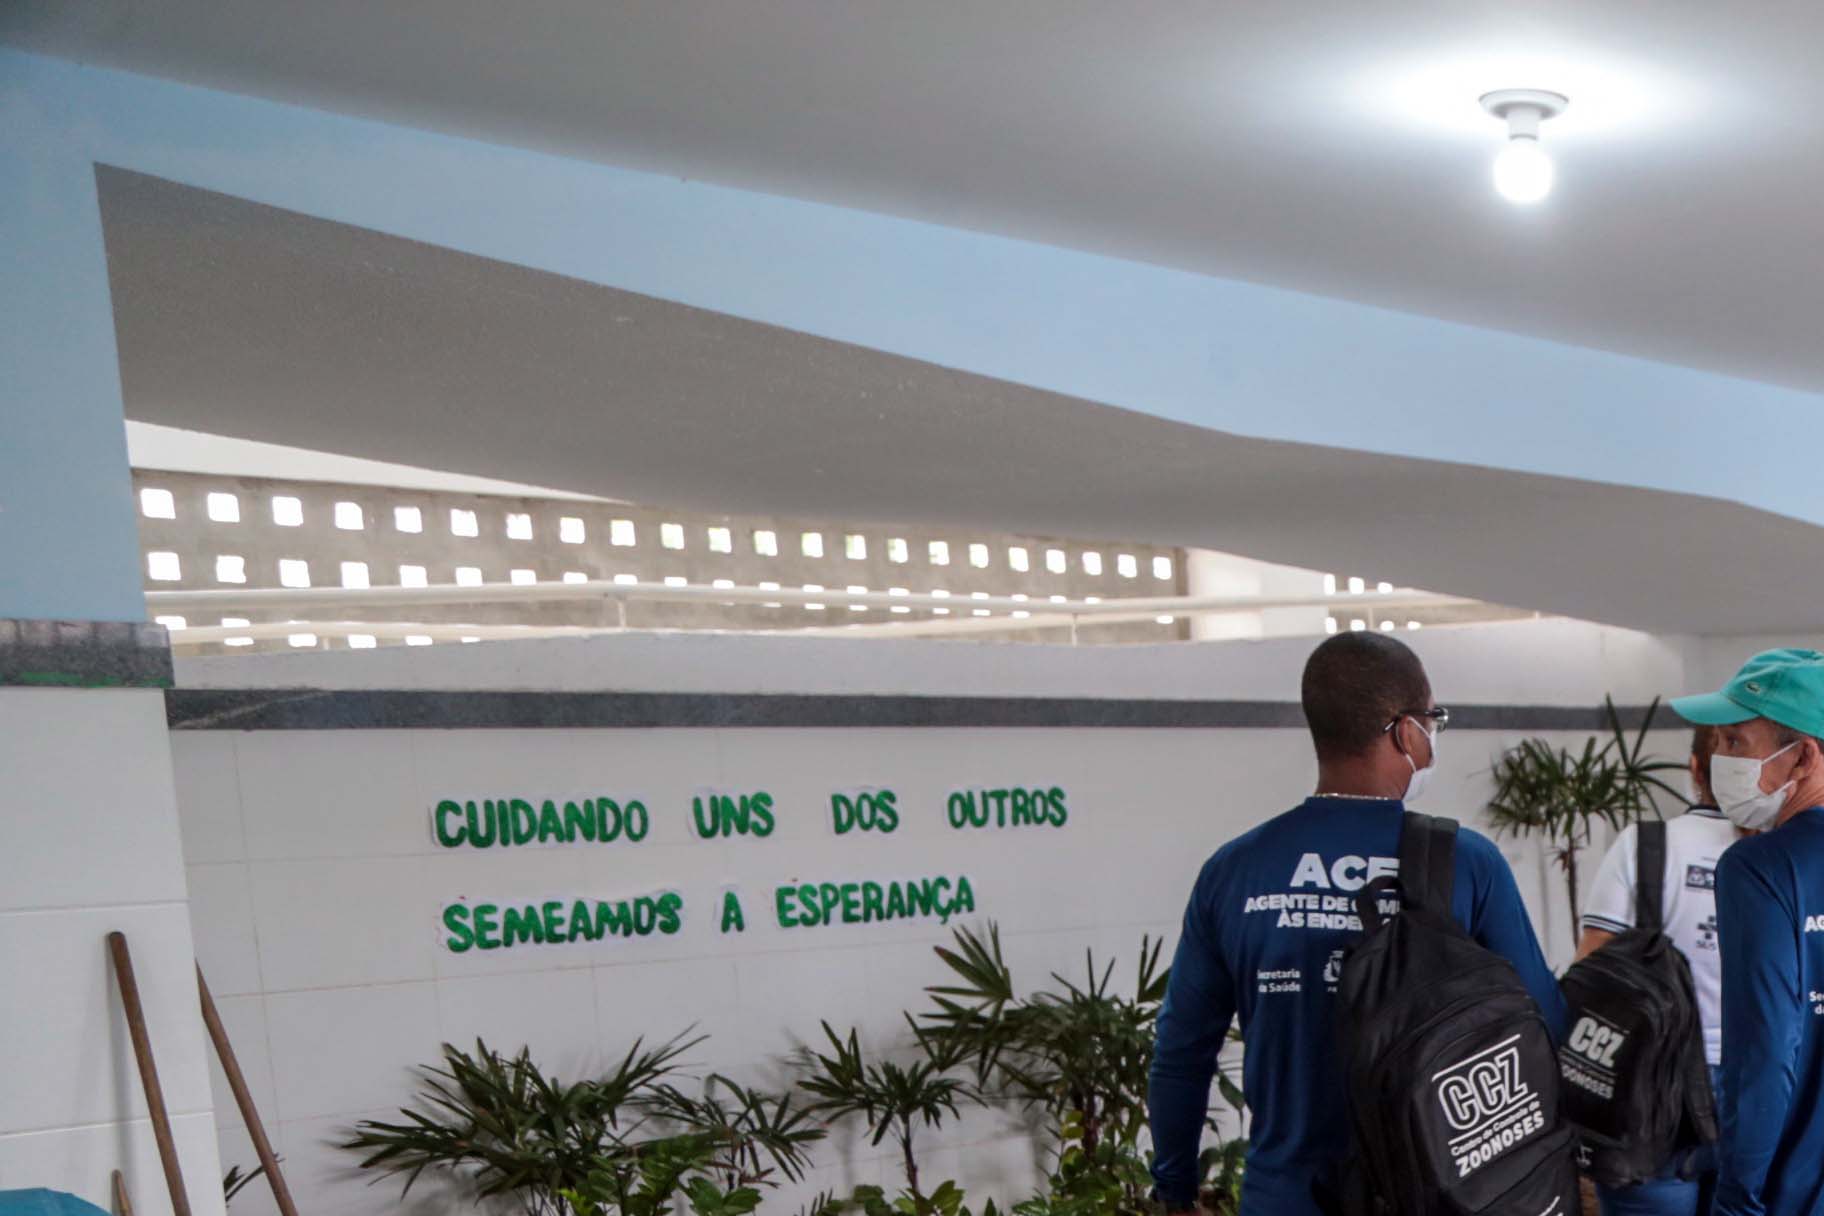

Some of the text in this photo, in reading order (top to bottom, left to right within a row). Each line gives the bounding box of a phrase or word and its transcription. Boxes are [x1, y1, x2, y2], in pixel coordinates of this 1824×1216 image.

[436, 788, 1067, 848] CUIDANDO UNS DOS OUTROS
[444, 877, 974, 953] SEMEAMOS A ESPERANÇA
[1244, 894, 1319, 913] AGENTE
[1323, 895, 1348, 912] DE
[1568, 1016, 1624, 1068] CCZ
[1438, 1046, 1529, 1131] CCZ
[1455, 1110, 1545, 1178] ZOONOSES
